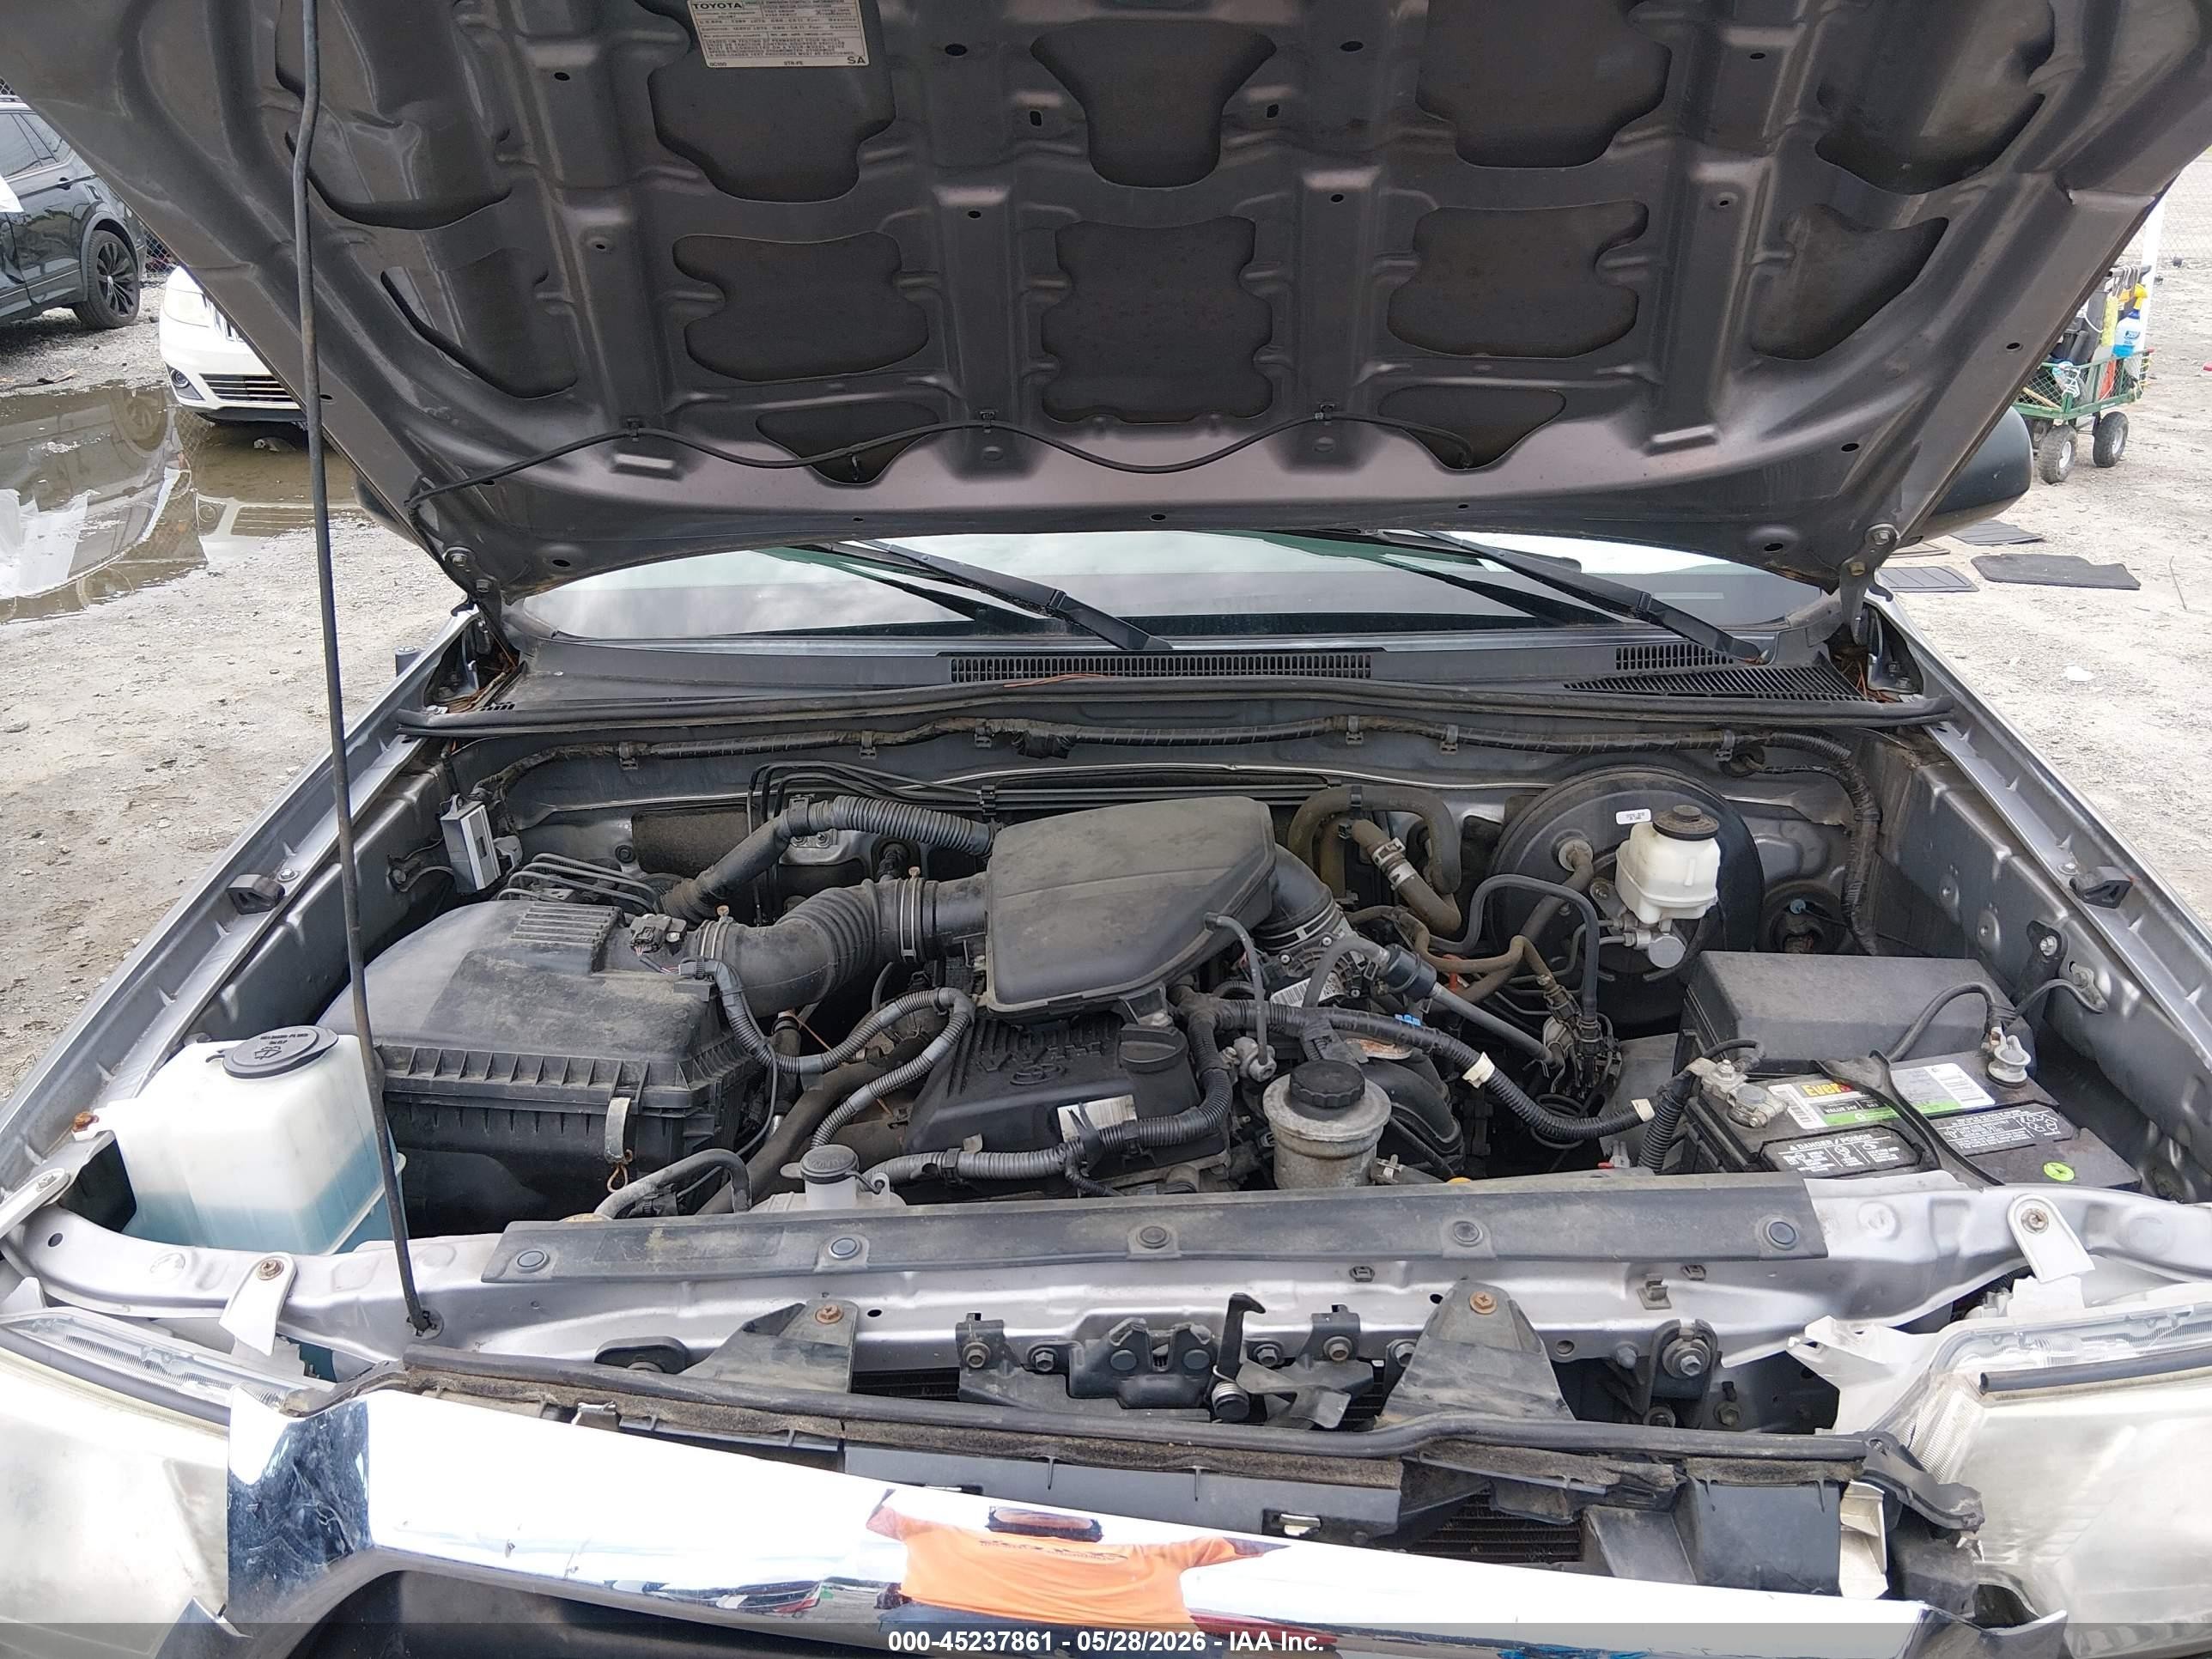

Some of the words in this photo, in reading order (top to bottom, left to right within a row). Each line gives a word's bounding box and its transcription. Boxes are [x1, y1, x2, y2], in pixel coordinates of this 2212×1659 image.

[847, 56, 866, 64] SA
[1796, 1139, 1833, 1150] DANGER
[1839, 1133, 1873, 1144] POISON
